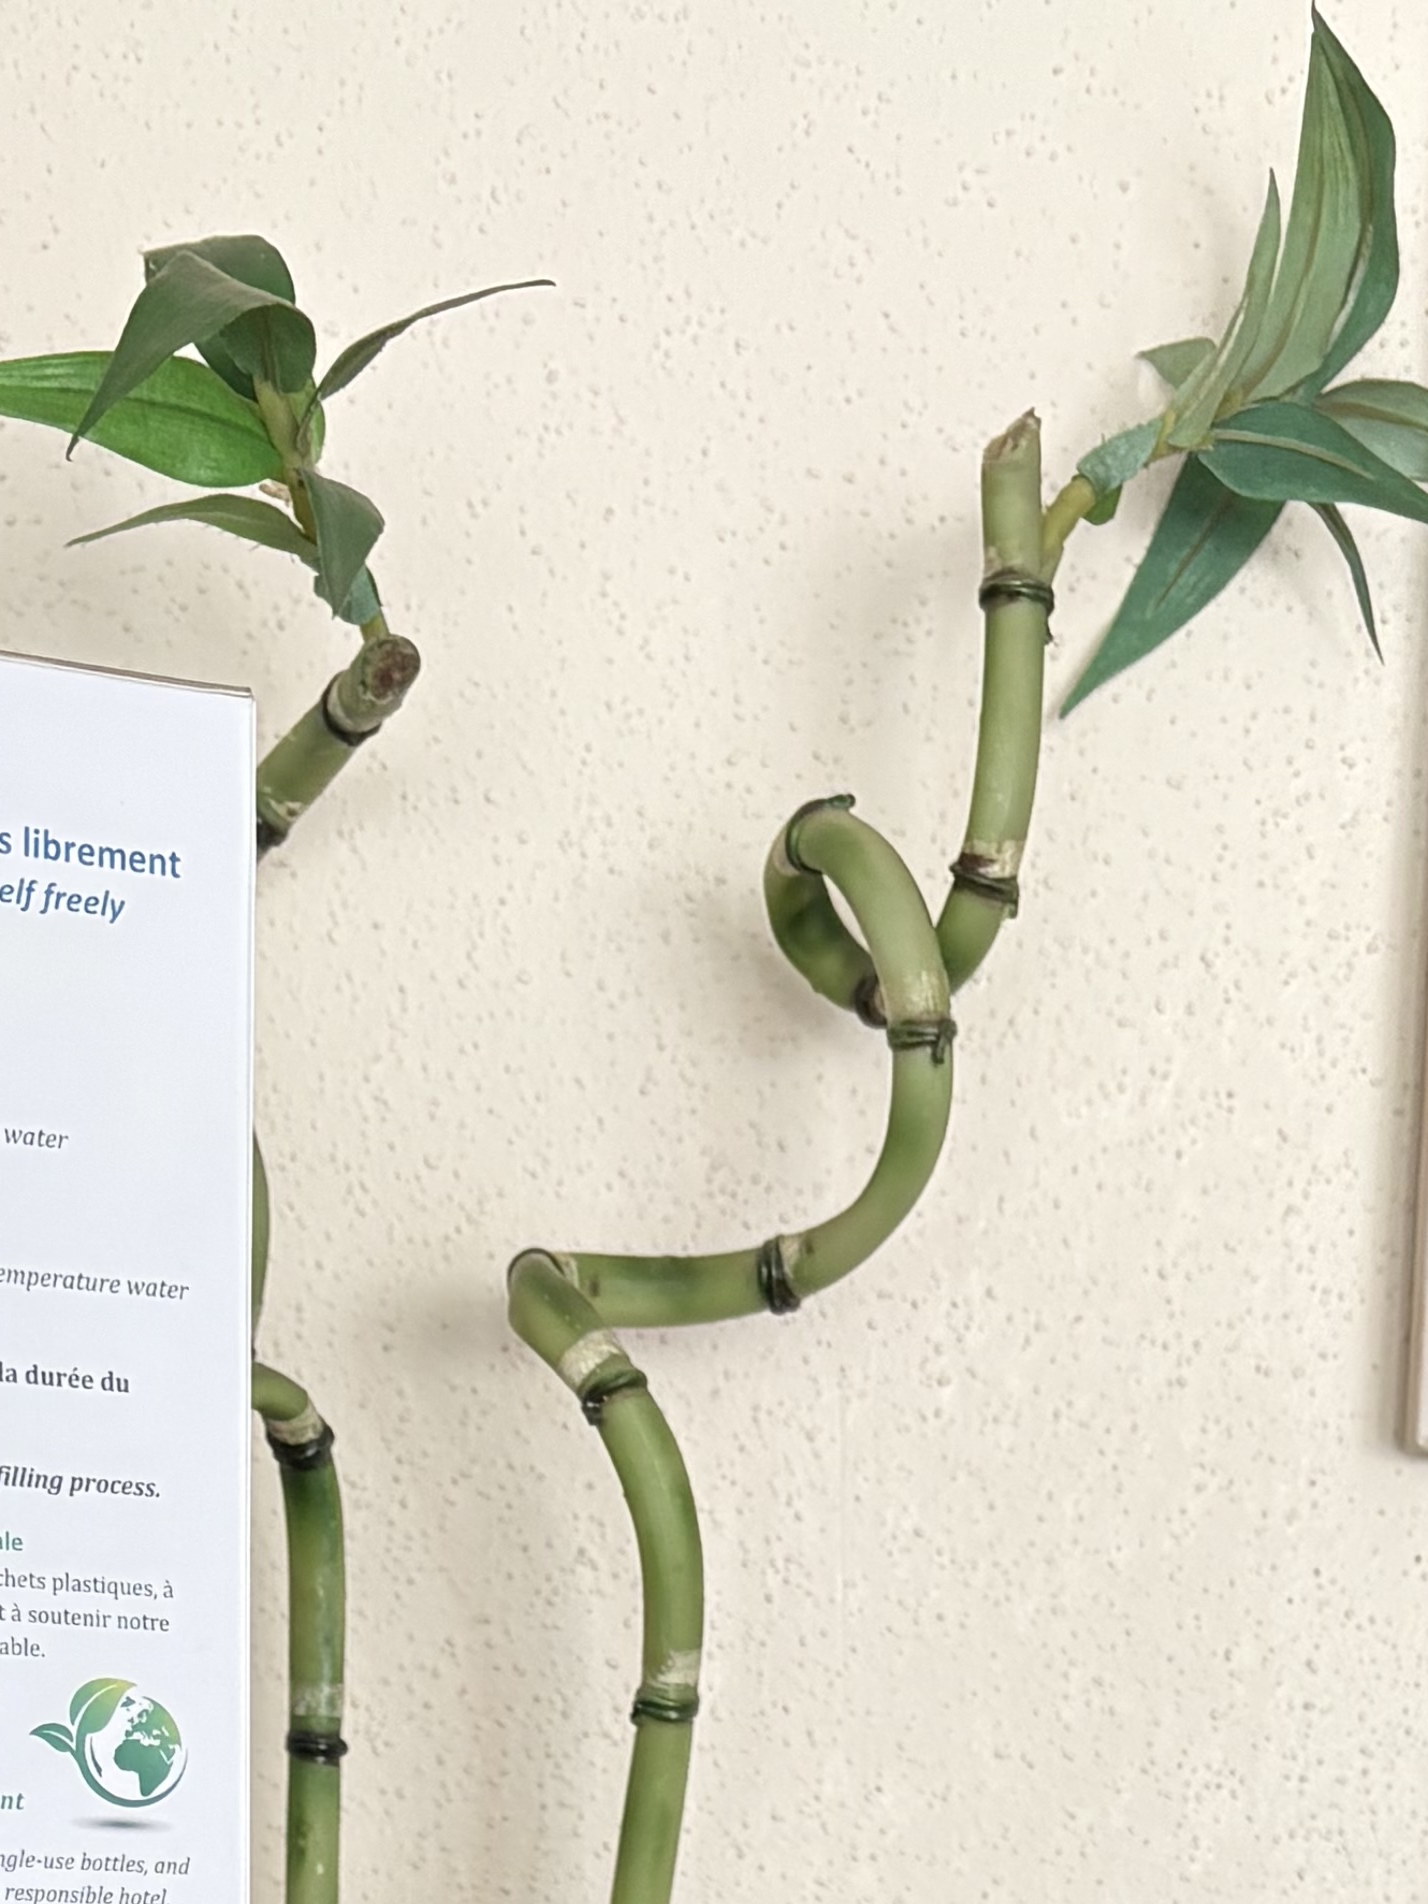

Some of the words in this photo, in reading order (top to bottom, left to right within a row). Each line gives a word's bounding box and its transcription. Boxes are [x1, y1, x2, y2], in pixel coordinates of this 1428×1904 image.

[23, 825, 182, 879] librement
[38, 881, 127, 926] freely
[3, 1127, 69, 1150] water
[126, 1279, 190, 1300] water
[24, 1363, 95, 1391] durée
[100, 1370, 130, 1394] du
[68, 1475, 161, 1499] process.
[51, 1571, 158, 1601] plastiques,
[162, 1579, 174, 1599] à
[10, 1602, 22, 1623] à
[27, 1608, 112, 1629] soutenir
[116, 1614, 170, 1633] notre
[80, 1851, 148, 1877] bottles,
[153, 1856, 191, 1875] and
